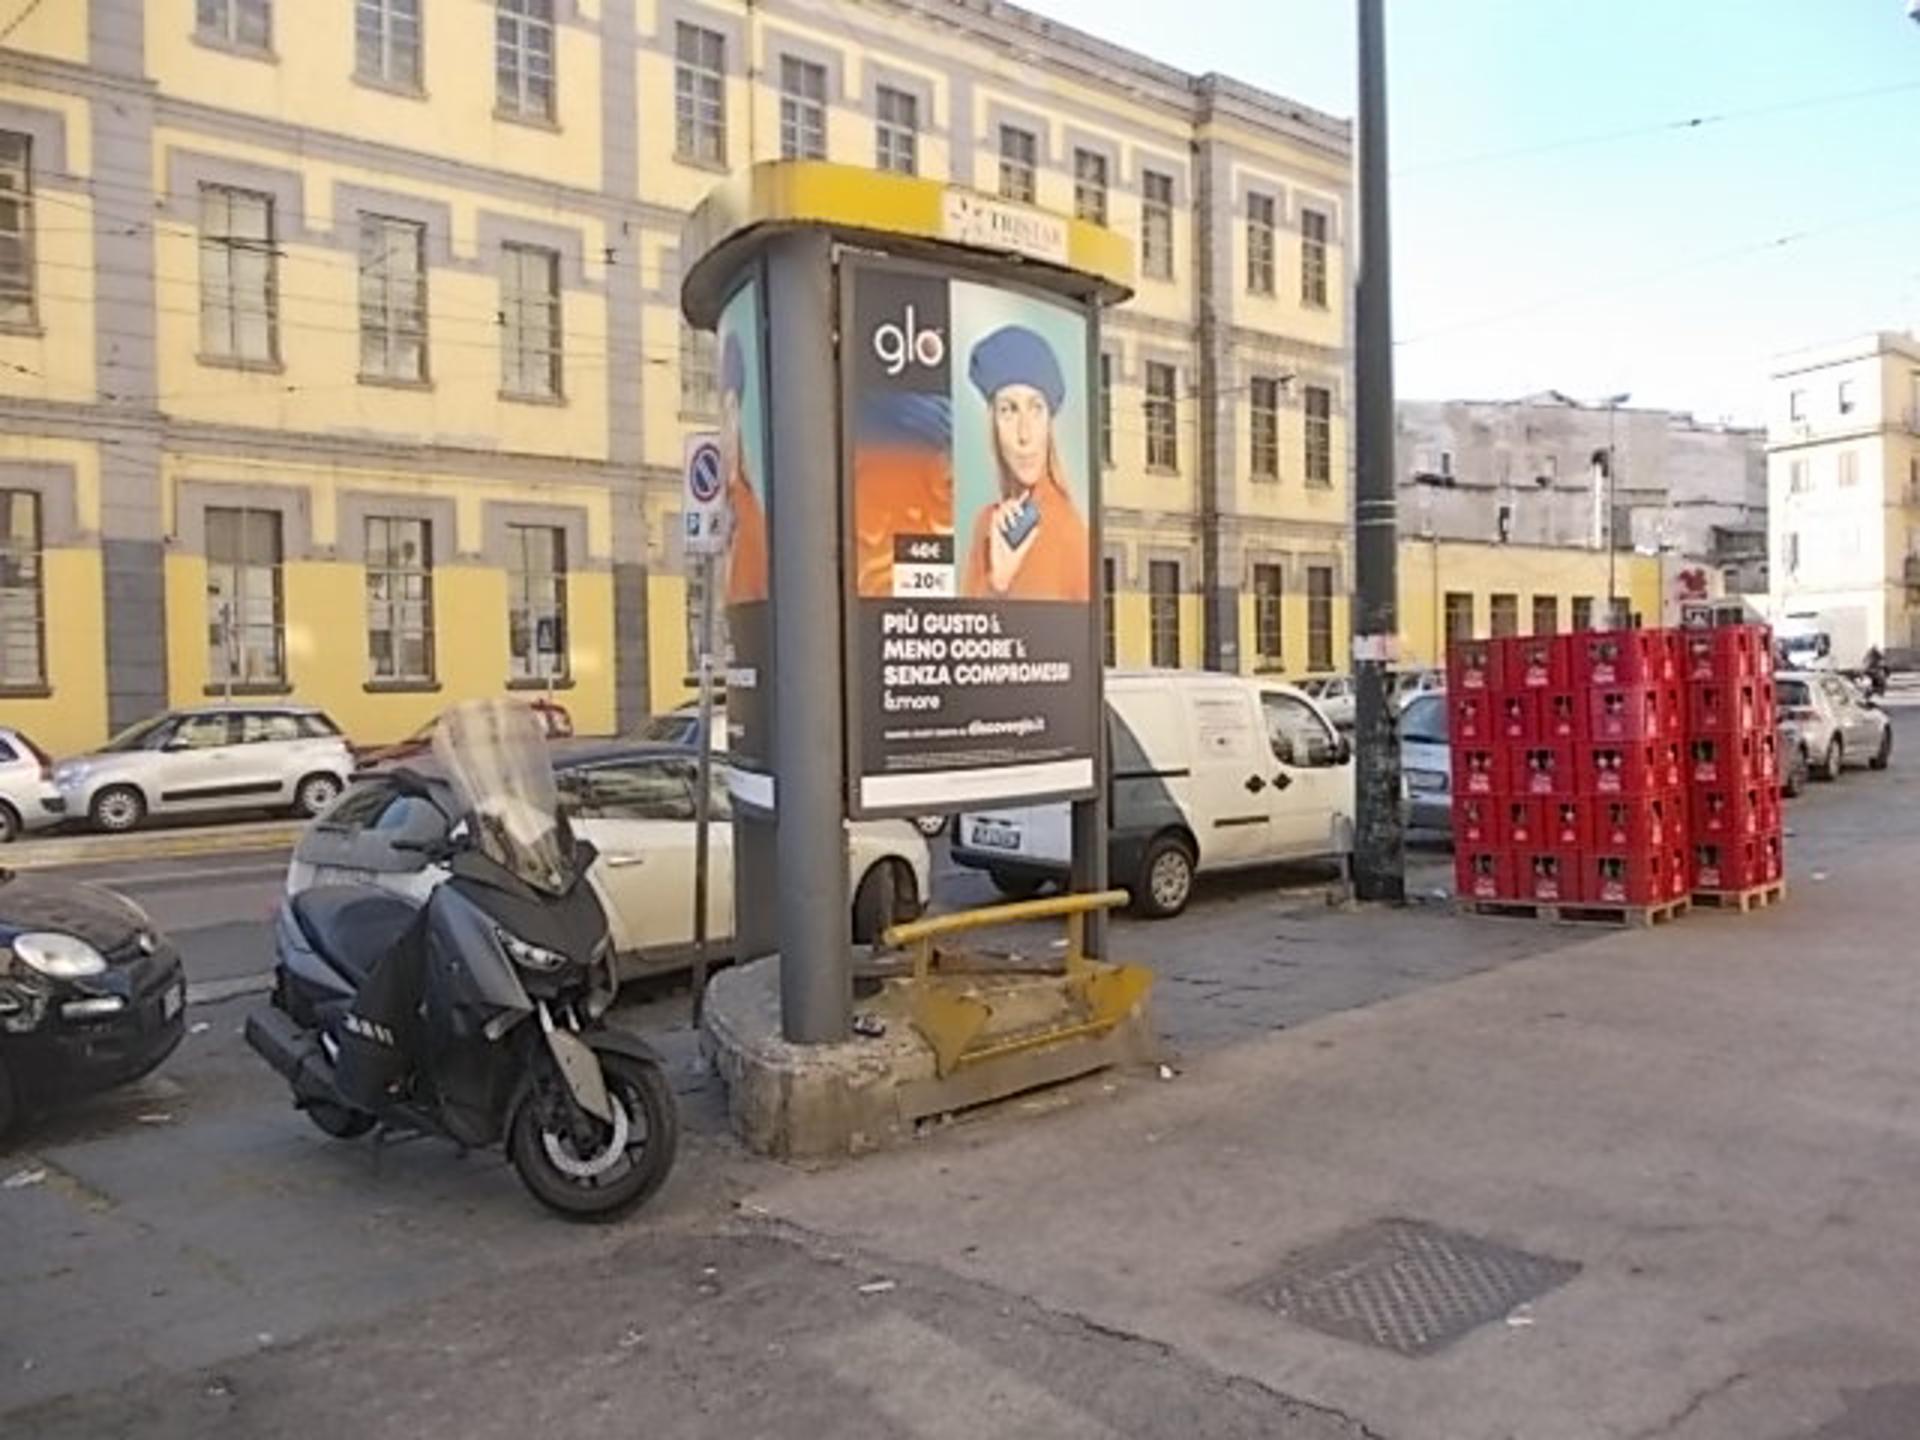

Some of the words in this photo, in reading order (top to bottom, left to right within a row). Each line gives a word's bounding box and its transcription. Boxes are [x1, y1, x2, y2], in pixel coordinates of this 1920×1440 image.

[874, 304, 944, 376] glo
[883, 609, 919, 634] PIÙ
[923, 613, 988, 634] GUSTO
[883, 639, 946, 660] MENO
[883, 665, 950, 685] SENZA
